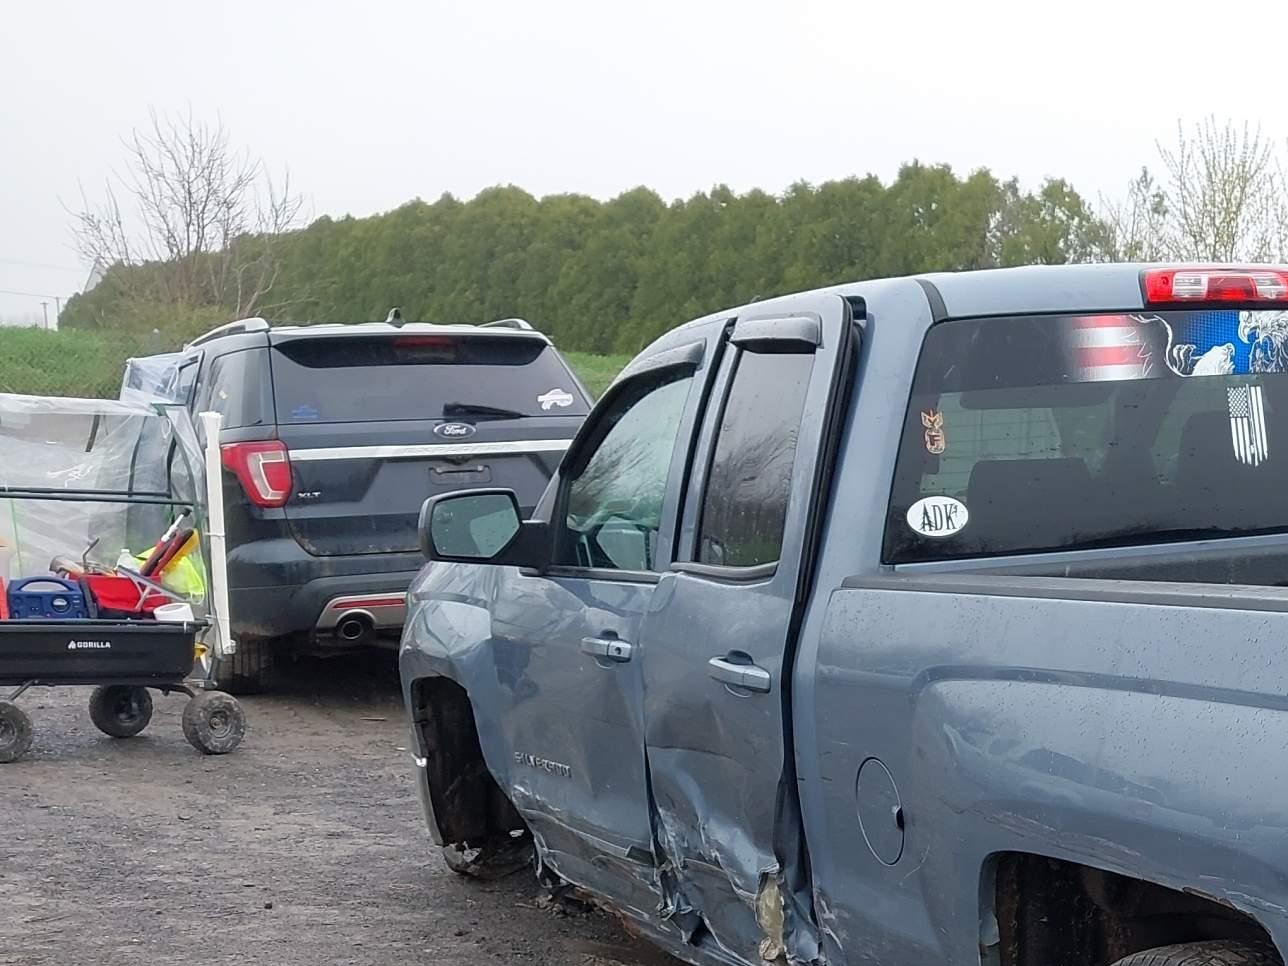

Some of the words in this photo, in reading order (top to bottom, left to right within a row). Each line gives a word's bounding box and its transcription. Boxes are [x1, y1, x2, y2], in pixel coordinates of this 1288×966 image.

[443, 425, 467, 435] Ford
[298, 491, 321, 499] XLT
[76, 641, 111, 649] GORILLA
